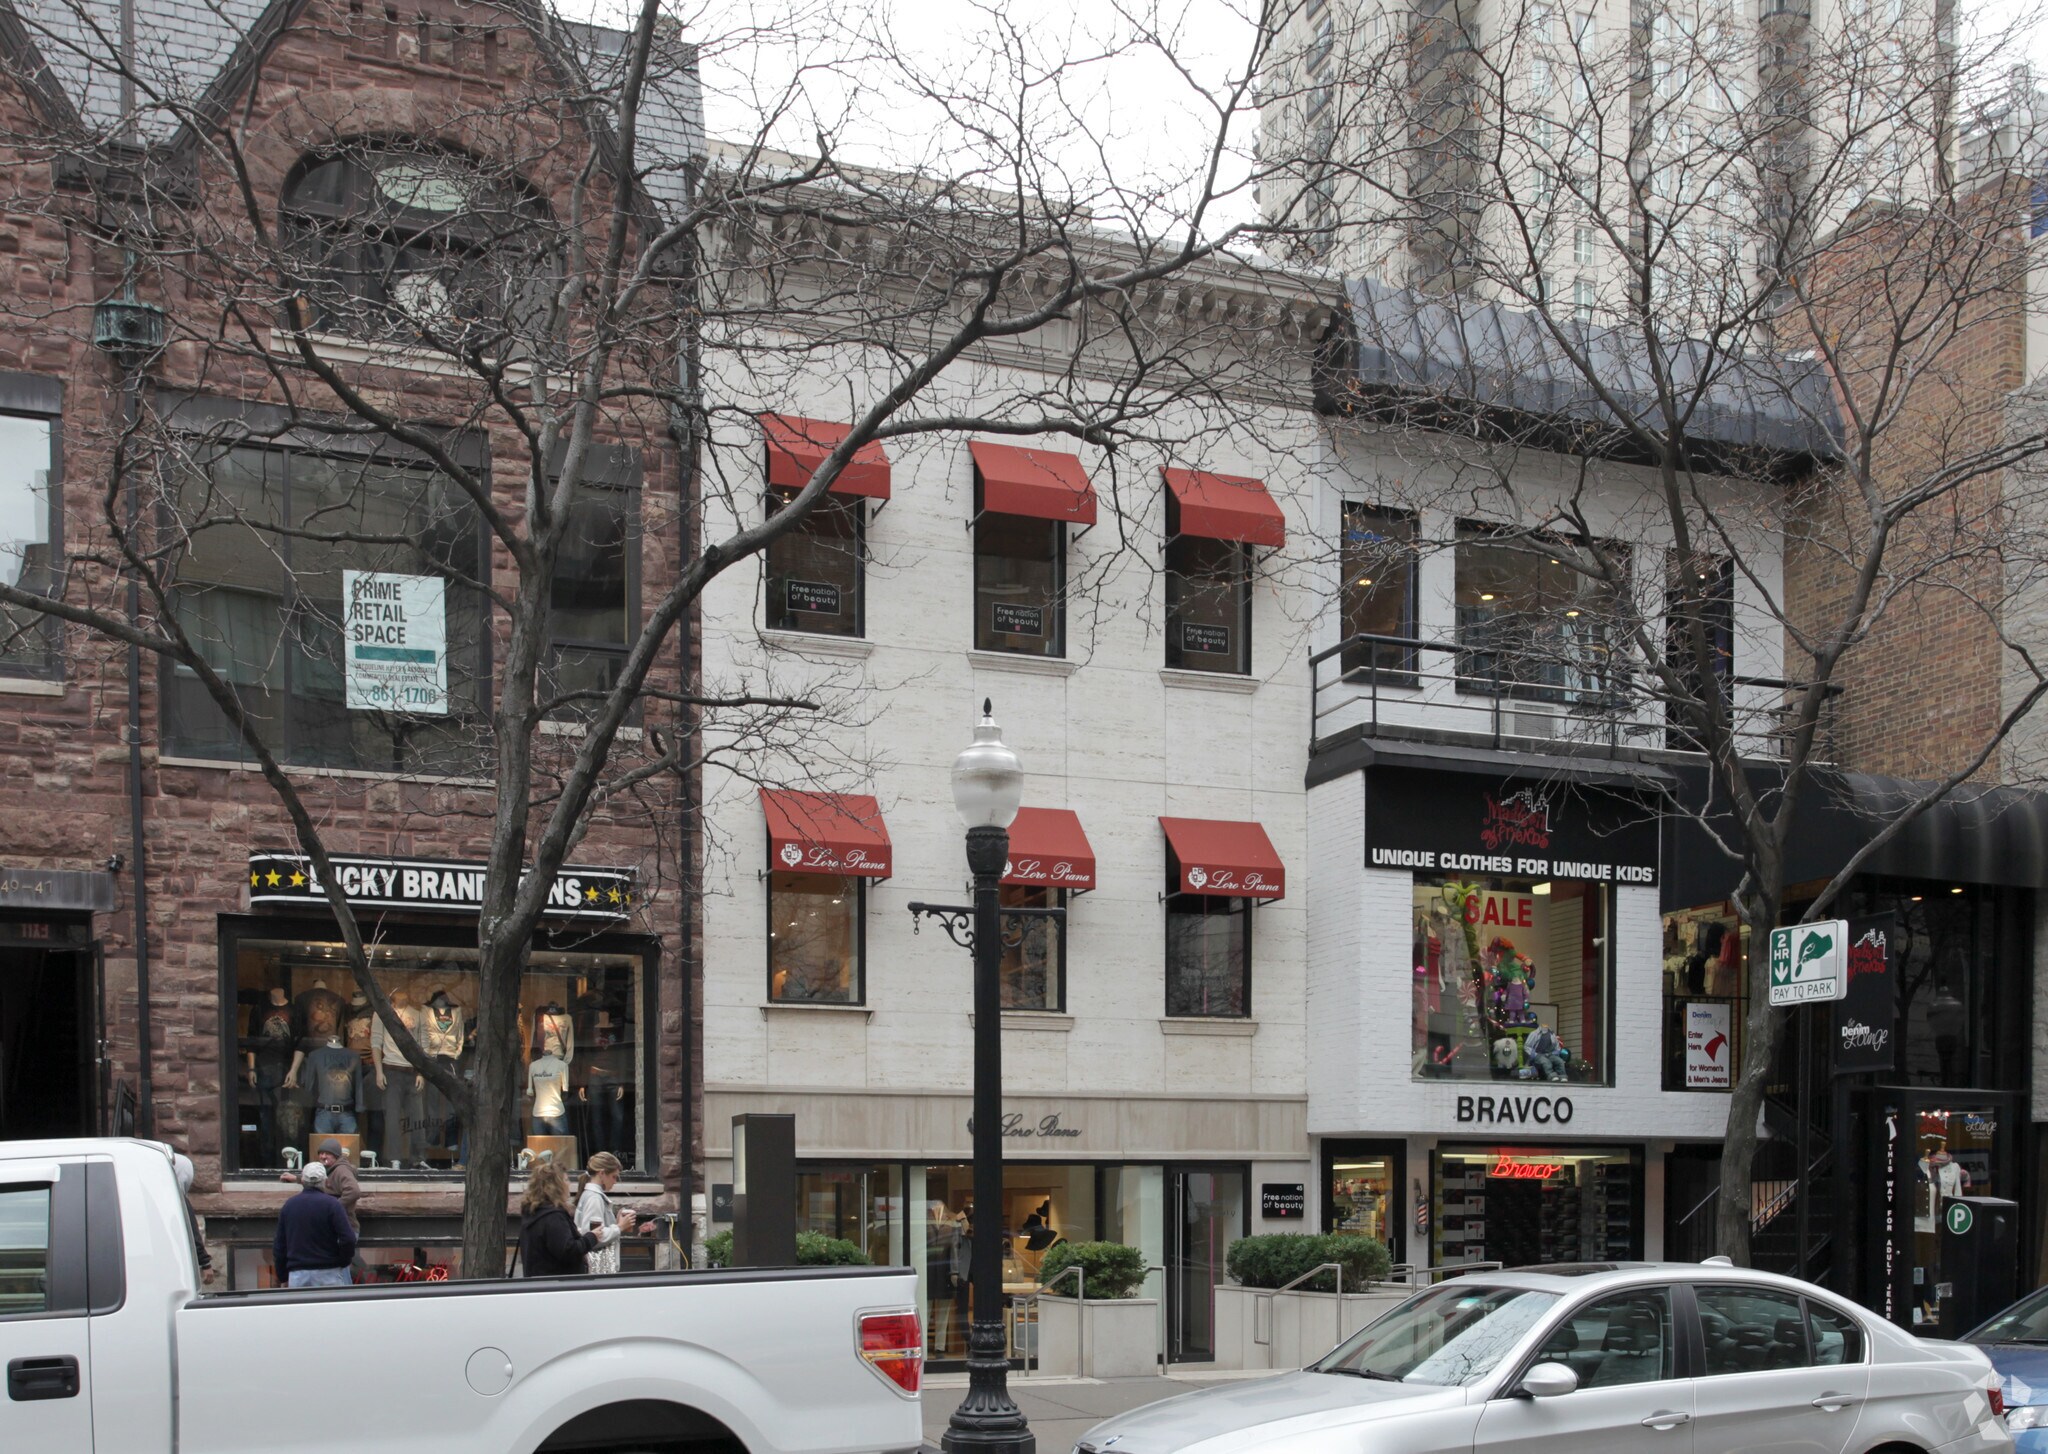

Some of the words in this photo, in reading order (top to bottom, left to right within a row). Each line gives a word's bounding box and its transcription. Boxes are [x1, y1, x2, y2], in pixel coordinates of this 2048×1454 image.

[353, 579, 401, 600] PRIME
[792, 584, 809, 592] Free
[811, 588, 836, 596] nation
[804, 594, 836, 606] beauty
[353, 602, 407, 622] RETAIL
[997, 607, 1014, 615] Free
[1016, 610, 1039, 618] nation
[1009, 617, 1039, 627] beauty
[355, 624, 406, 644] SPACE
[1197, 636, 1226, 646] beauty
[803, 847, 838, 867] Loro
[844, 849, 886, 870] Piana
[1372, 848, 1435, 867] UNIQUE
[1440, 853, 1512, 873] CLOTHES
[1517, 858, 1548, 875] FOR
[1553, 861, 1612, 879] UNIQUE
[1616, 865, 1653, 882] KIDS
[1013, 860, 1046, 879] Loro
[1051, 862, 1090, 881] Piana
[1207, 870, 1239, 890] Loro
[1242, 873, 1280, 892] Piana
[1464, 894, 1533, 928] SALE
[1777, 933, 1787, 948] 2
[1774, 948, 1790, 960] HR
[1774, 987, 1790, 1000] PAY
[1793, 985, 1804, 998] TO
[1807, 982, 1832, 996] PARK
[1692, 1011, 1712, 1019] Denim
[1688, 1031, 1703, 1039] Enter
[1842, 1025, 1870, 1037] Denim
[1698, 1064, 1724, 1072] Women's
[1711, 1076, 1728, 1084] Jeans
[1457, 1096, 1573, 1124] BRAVCO
[1001, 1113, 1035, 1137] Loro
[1037, 1112, 1082, 1137] Piana
[1491, 1155, 1561, 1179] Bravco
[1886, 1180, 1894, 1202] WAY
[1274, 1201, 1303, 1211] beauty
[1954, 1208, 1966, 1229] P
